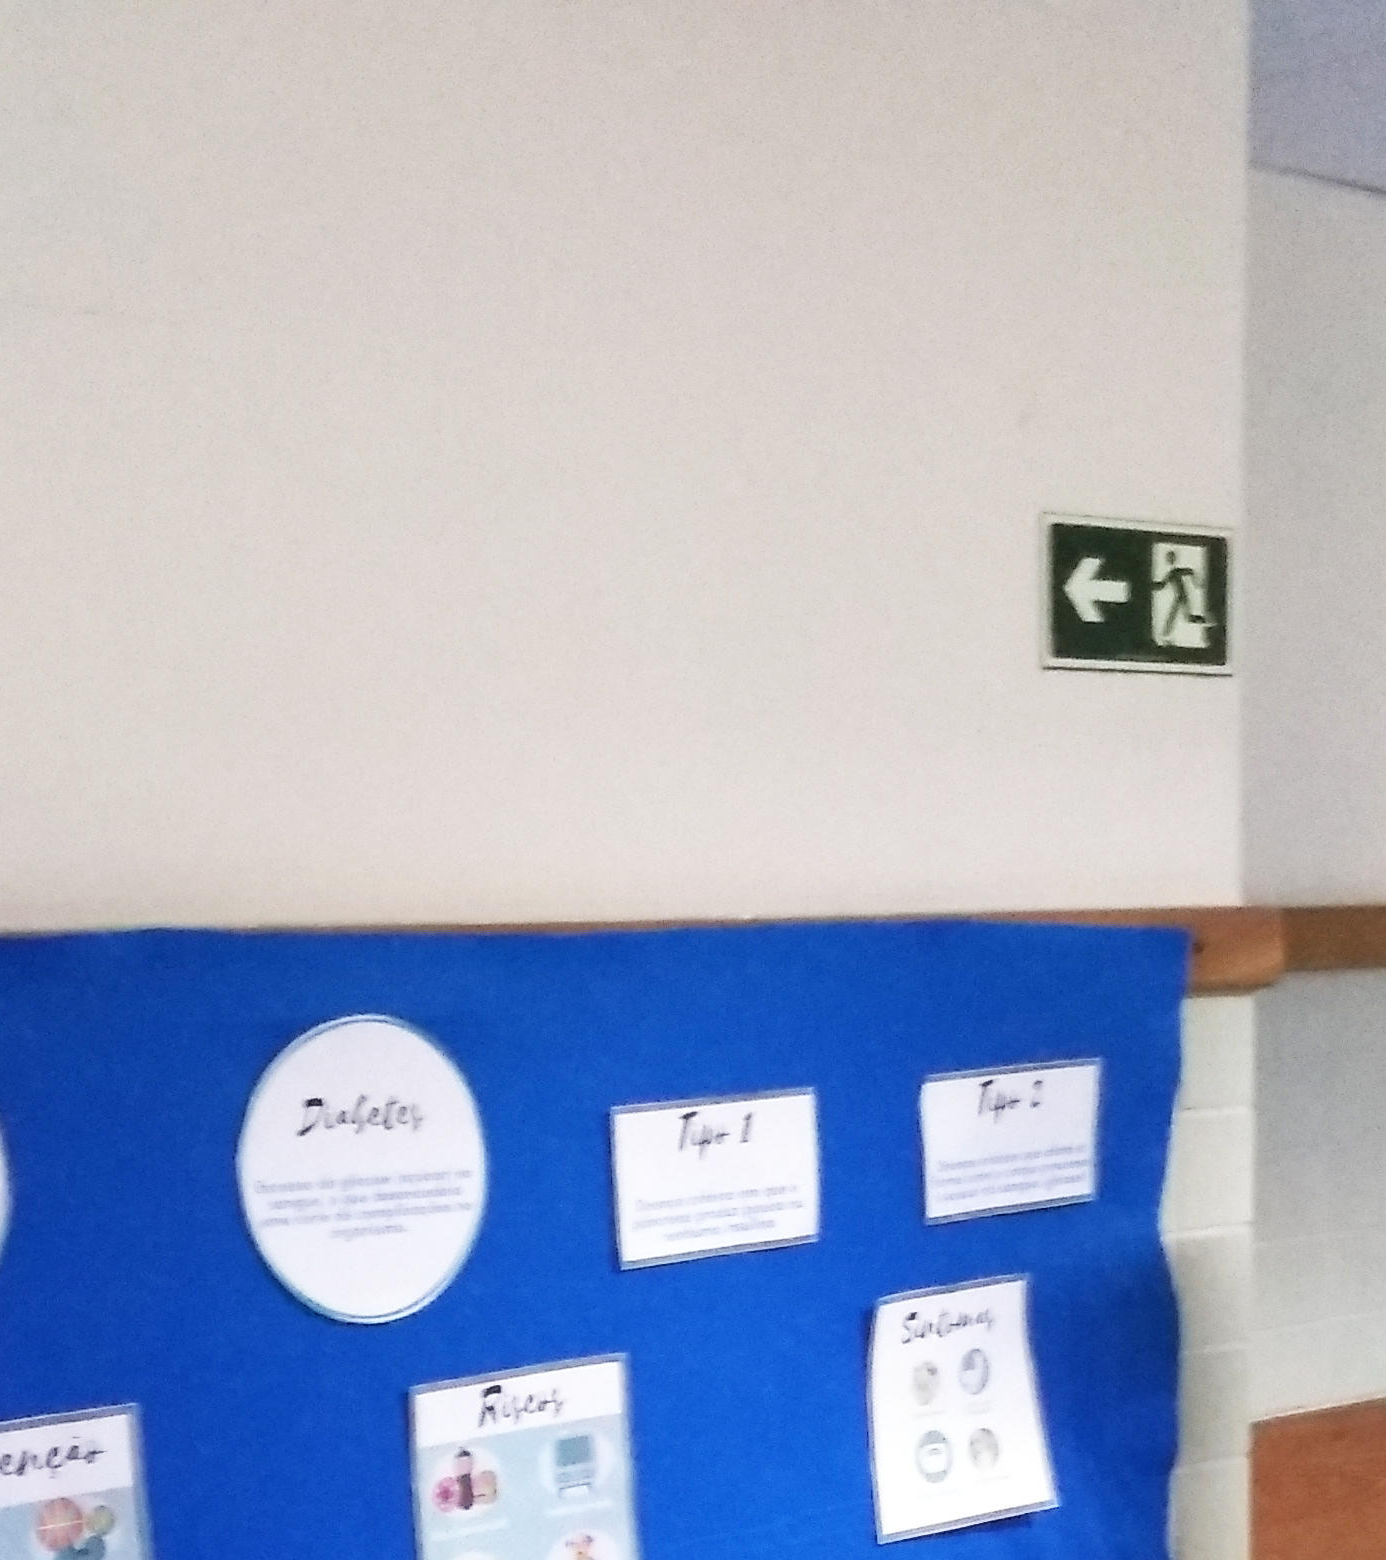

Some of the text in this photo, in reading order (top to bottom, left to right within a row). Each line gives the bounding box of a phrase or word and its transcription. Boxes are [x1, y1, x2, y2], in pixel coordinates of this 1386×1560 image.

[296, 1094, 425, 1137] Diabetes
[977, 1079, 1021, 1125] Tipo
[677, 1111, 754, 1161] Tipo 1
[901, 1308, 994, 1345] Sintomas
[477, 1384, 565, 1429] Riscos
